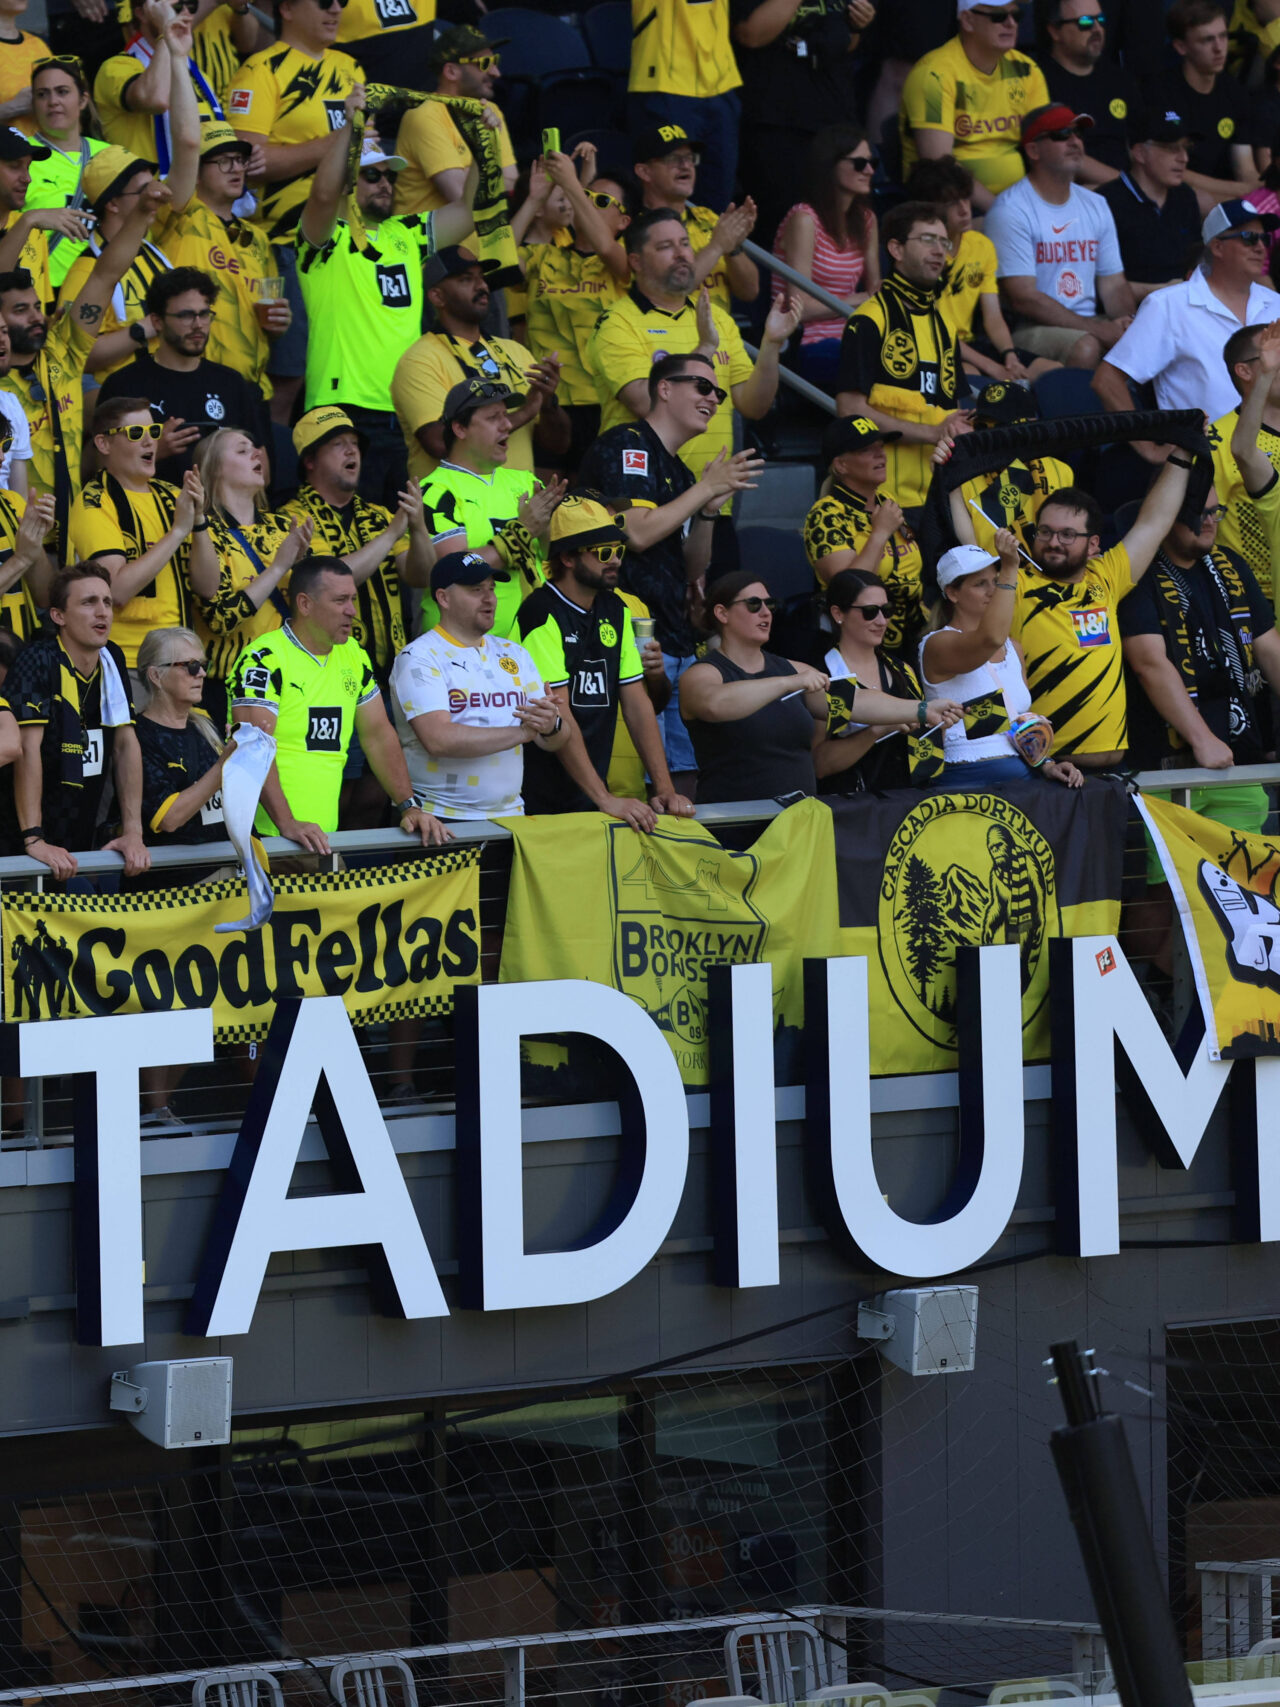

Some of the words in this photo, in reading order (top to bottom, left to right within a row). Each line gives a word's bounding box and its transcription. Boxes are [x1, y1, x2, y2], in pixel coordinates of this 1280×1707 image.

[379, 273, 408, 297] 1&1
[894, 335, 908, 373] BVB
[600, 623, 616, 640] BVB
[1076, 611, 1108, 636] 1&1
[579, 670, 605, 693] 1&1
[311, 717, 339, 741] 1&1
[881, 795, 956, 901] CASCADIA
[963, 795, 1055, 896] DORTMUND
[74, 898, 480, 1010] GoodFellas
